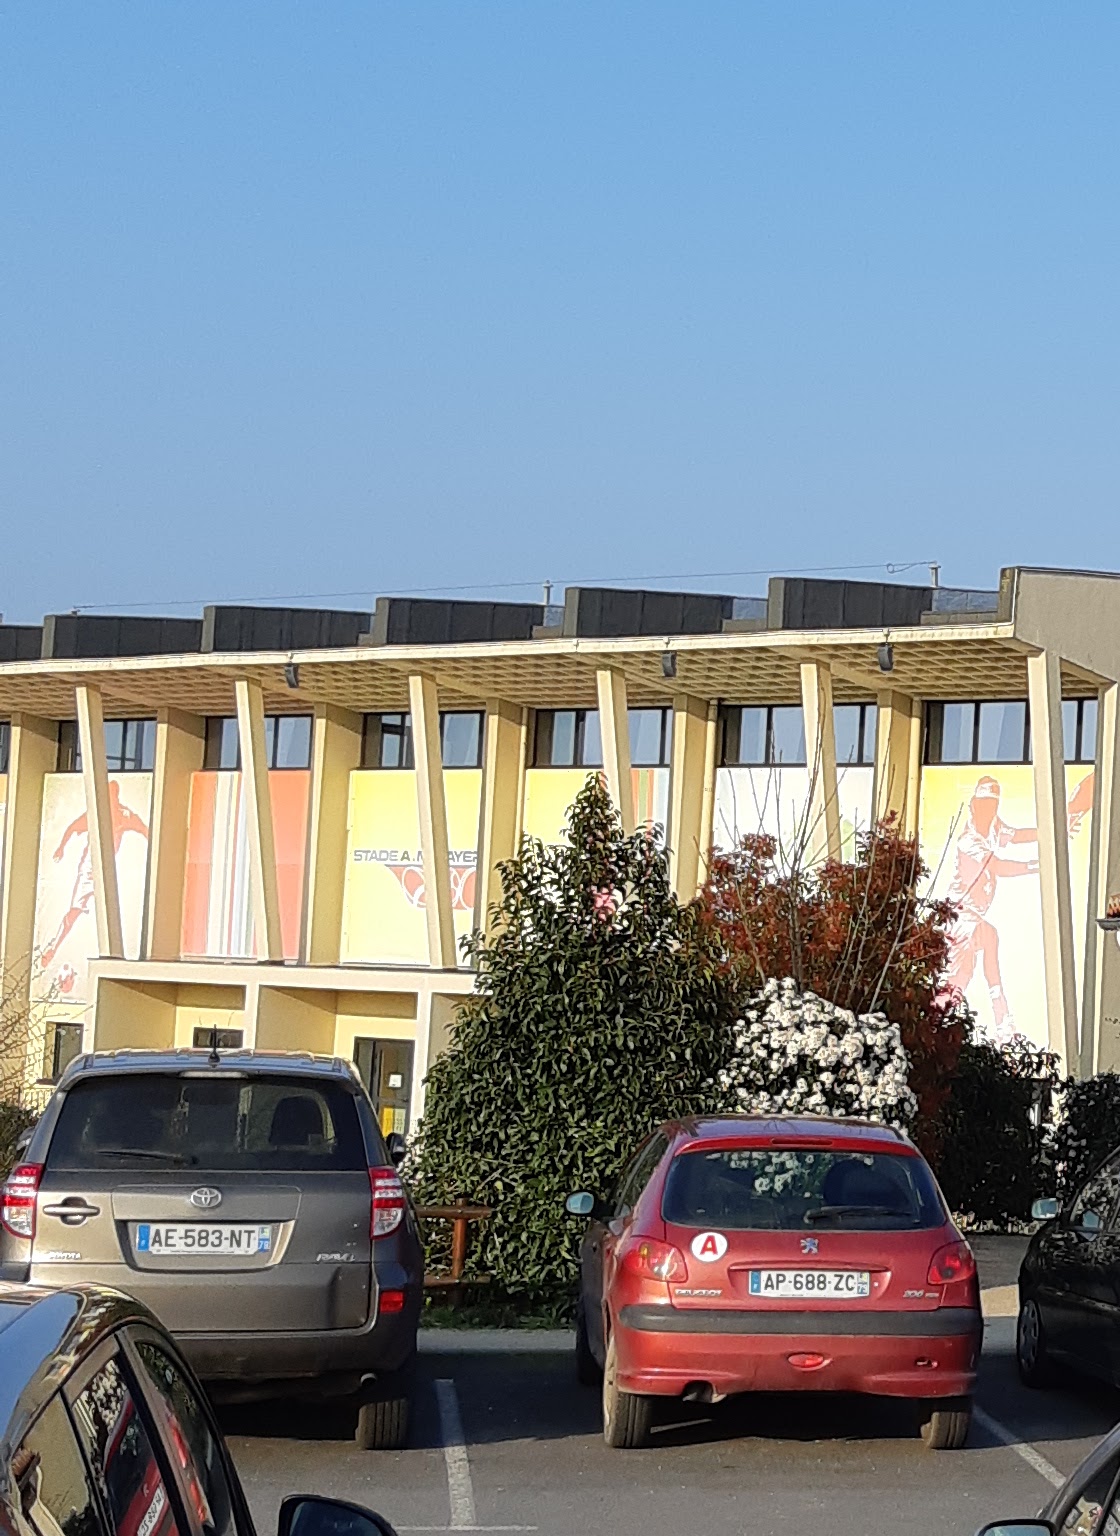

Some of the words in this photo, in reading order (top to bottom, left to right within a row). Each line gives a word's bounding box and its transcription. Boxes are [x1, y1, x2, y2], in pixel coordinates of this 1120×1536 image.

[354, 849, 398, 862] STADE
[151, 1228, 255, 1248] AE-583-NT
[699, 1235, 718, 1255] A
[763, 1273, 855, 1292] AP-688-ZC
